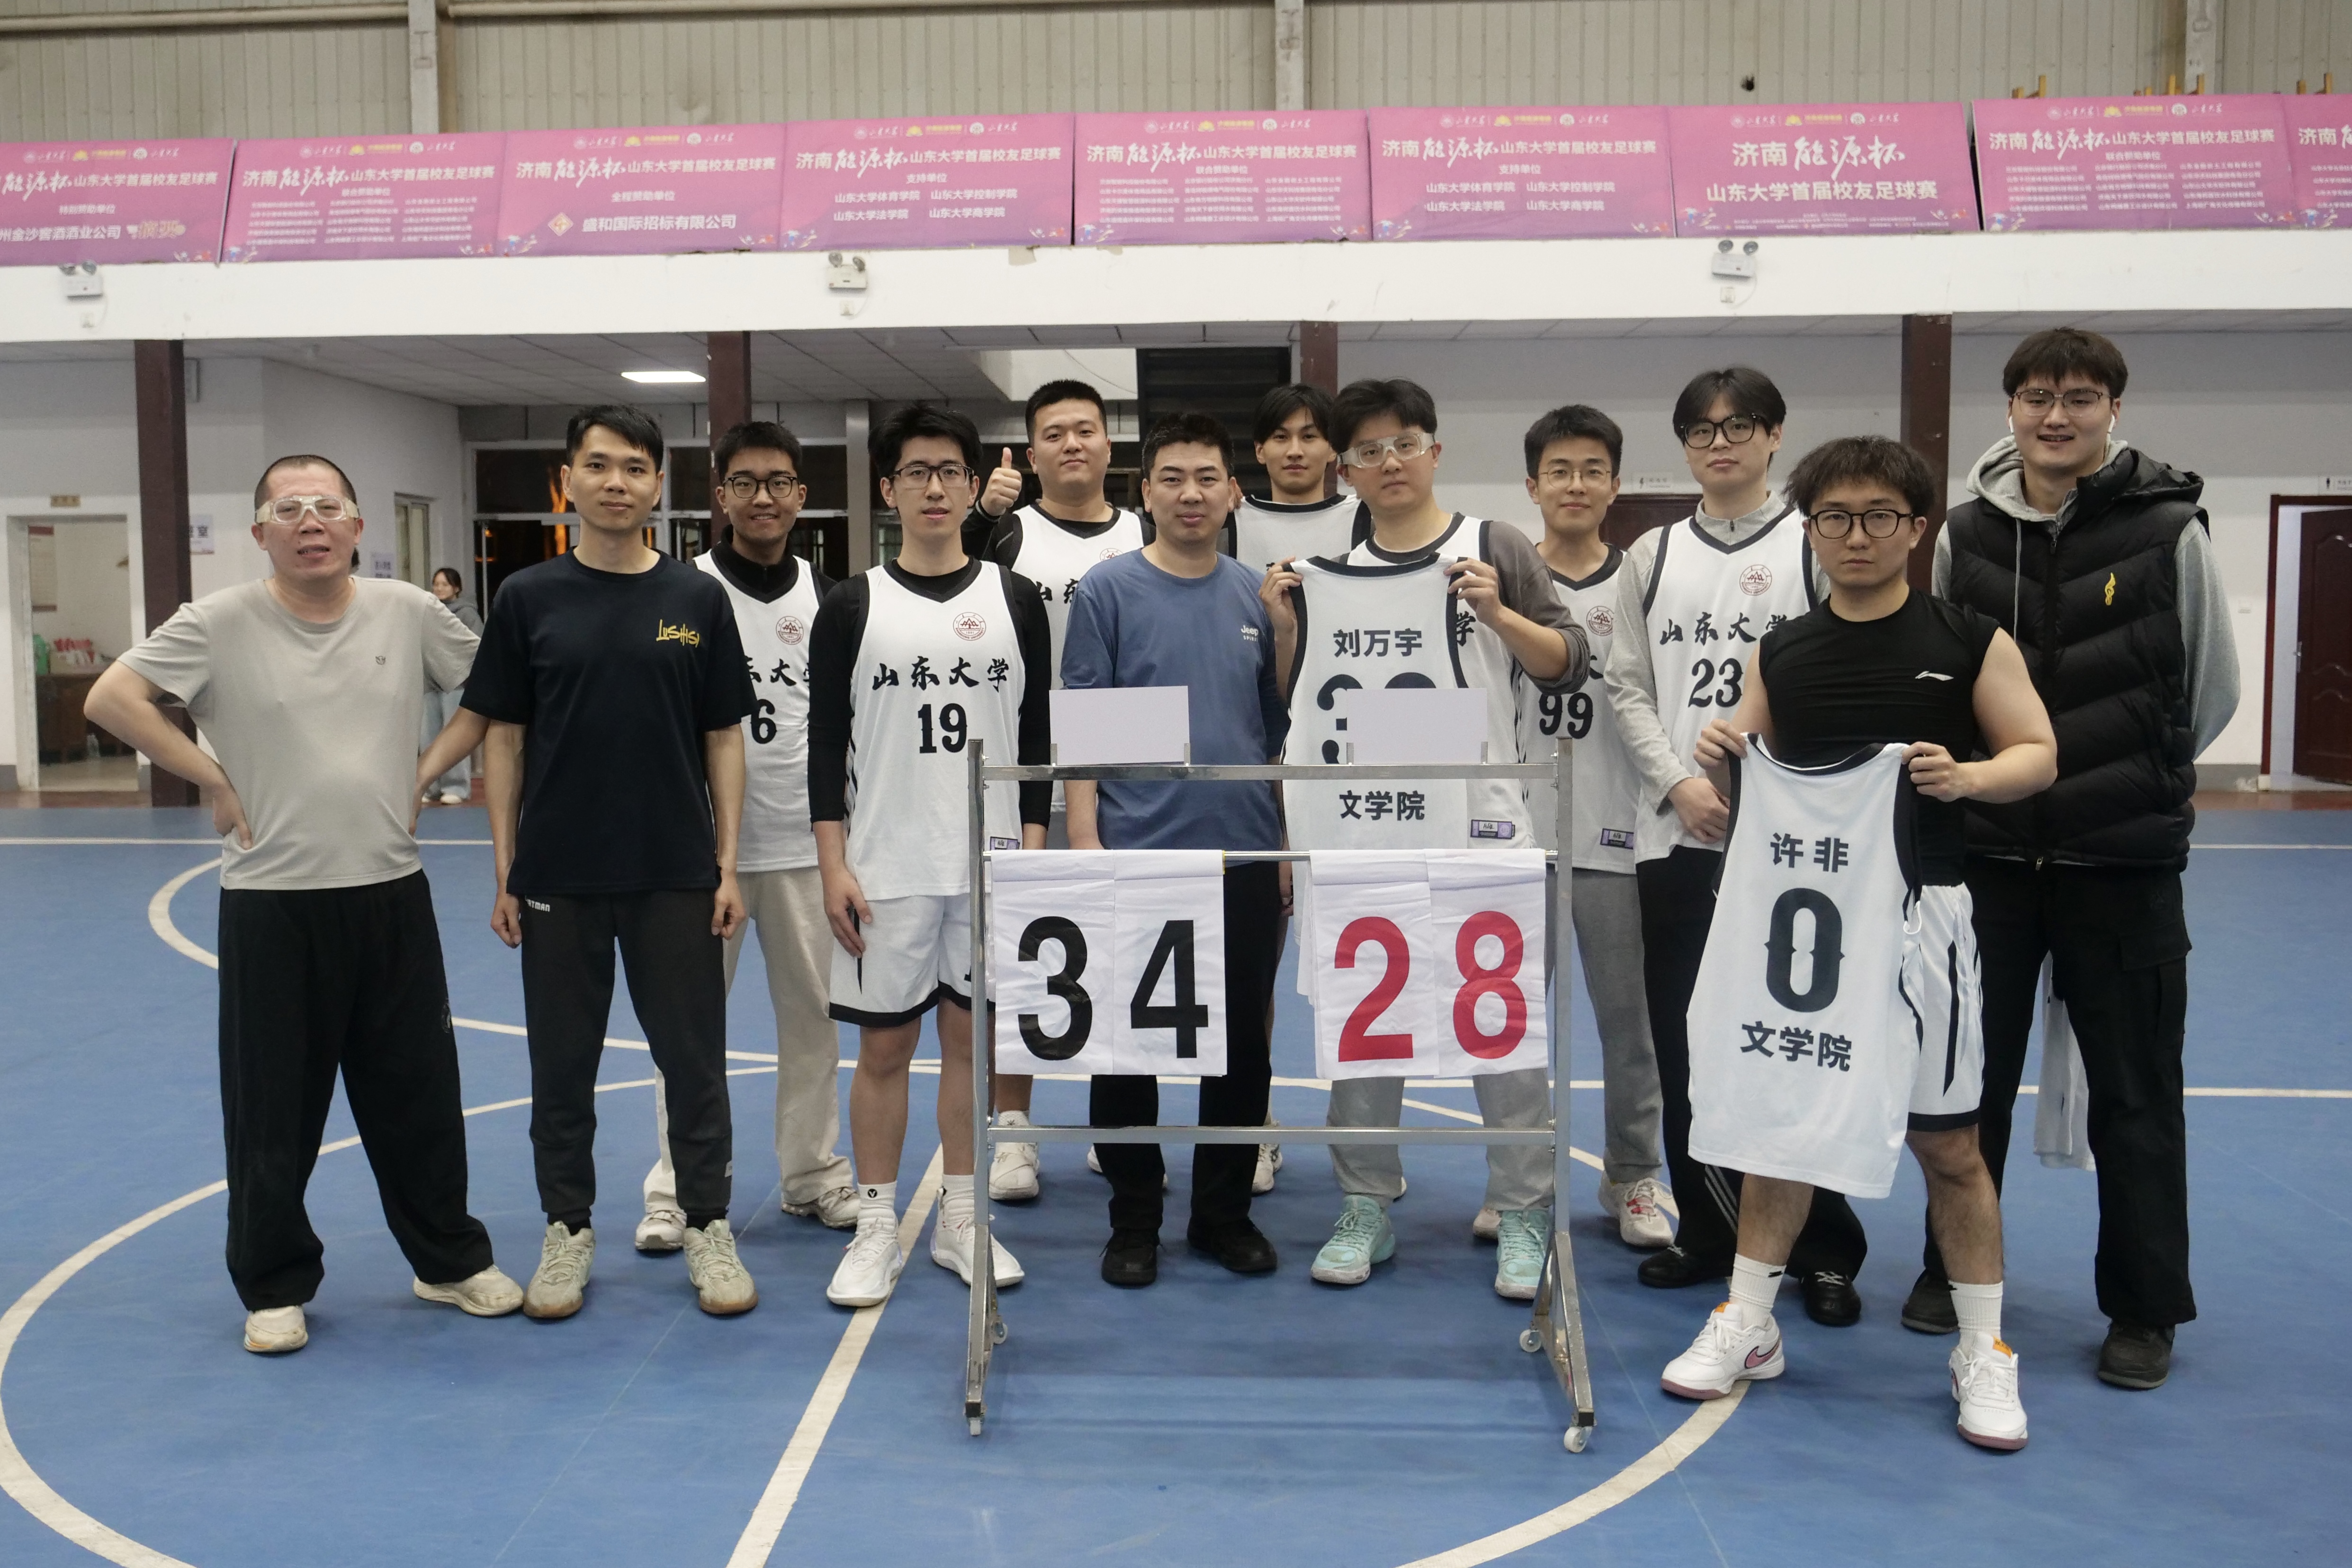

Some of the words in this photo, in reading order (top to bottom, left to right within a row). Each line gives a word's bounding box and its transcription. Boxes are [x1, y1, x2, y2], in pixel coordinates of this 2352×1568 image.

[0, 170, 218, 201] 能源杯山东大学首届校友足球赛
[906, 172, 947, 184] 支持单位
[1499, 163, 1541, 175] 支持单位
[1706, 180, 1939, 202] 山东大学首届校友足球赛
[1241, 625, 1259, 636] Jeep
[1333, 628, 1422, 657] 刘万宇
[872, 656, 1010, 692] 山东大学
[1688, 658, 1743, 708] 23
[917, 703, 968, 754] 19
[1538, 692, 1594, 739] 99
[1339, 790, 1425, 821] 文学院
[1770, 833, 1849, 873] 许非
[1765, 887, 1845, 1013] 0
[1017, 916, 1209, 1061] 34
[1334, 910, 1527, 1063] 28
[1741, 1021, 1853, 1072] 文学院
